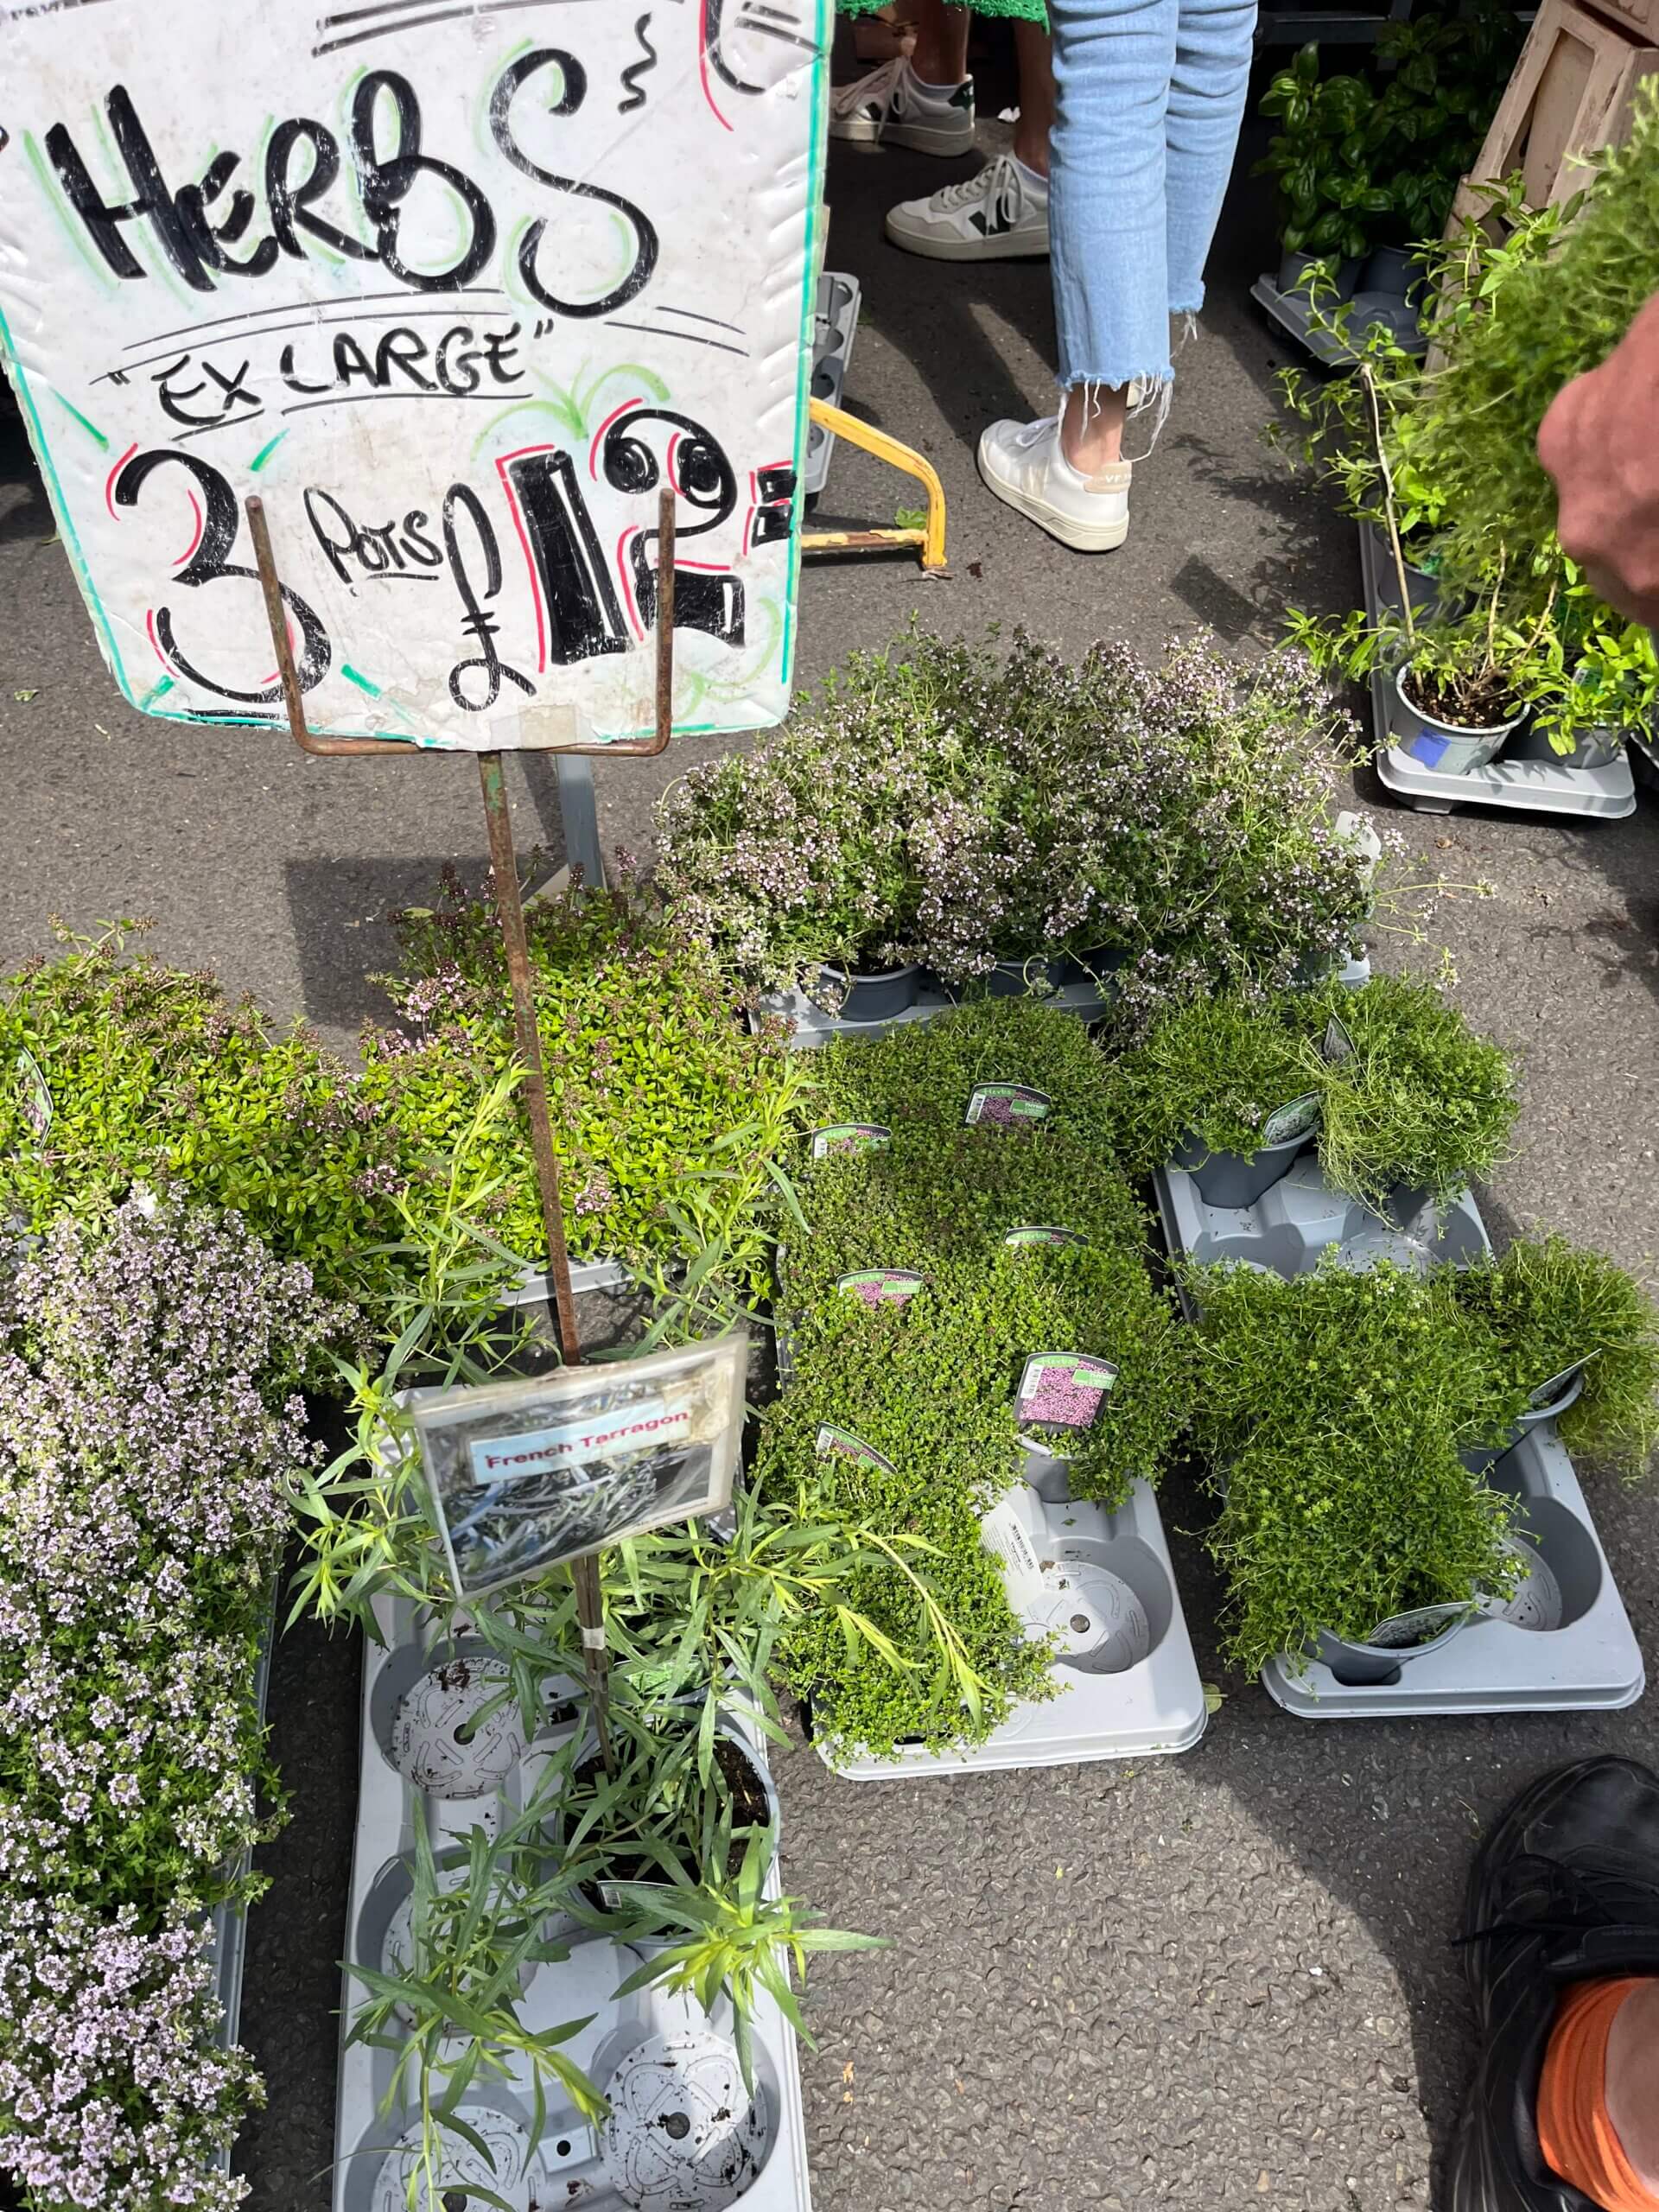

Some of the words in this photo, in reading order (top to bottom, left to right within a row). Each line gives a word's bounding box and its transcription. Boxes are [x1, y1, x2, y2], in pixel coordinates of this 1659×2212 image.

[115, 448, 332, 704] 3
[486, 1442, 573, 1469] French
[580, 1409, 690, 1447] Tarragon
